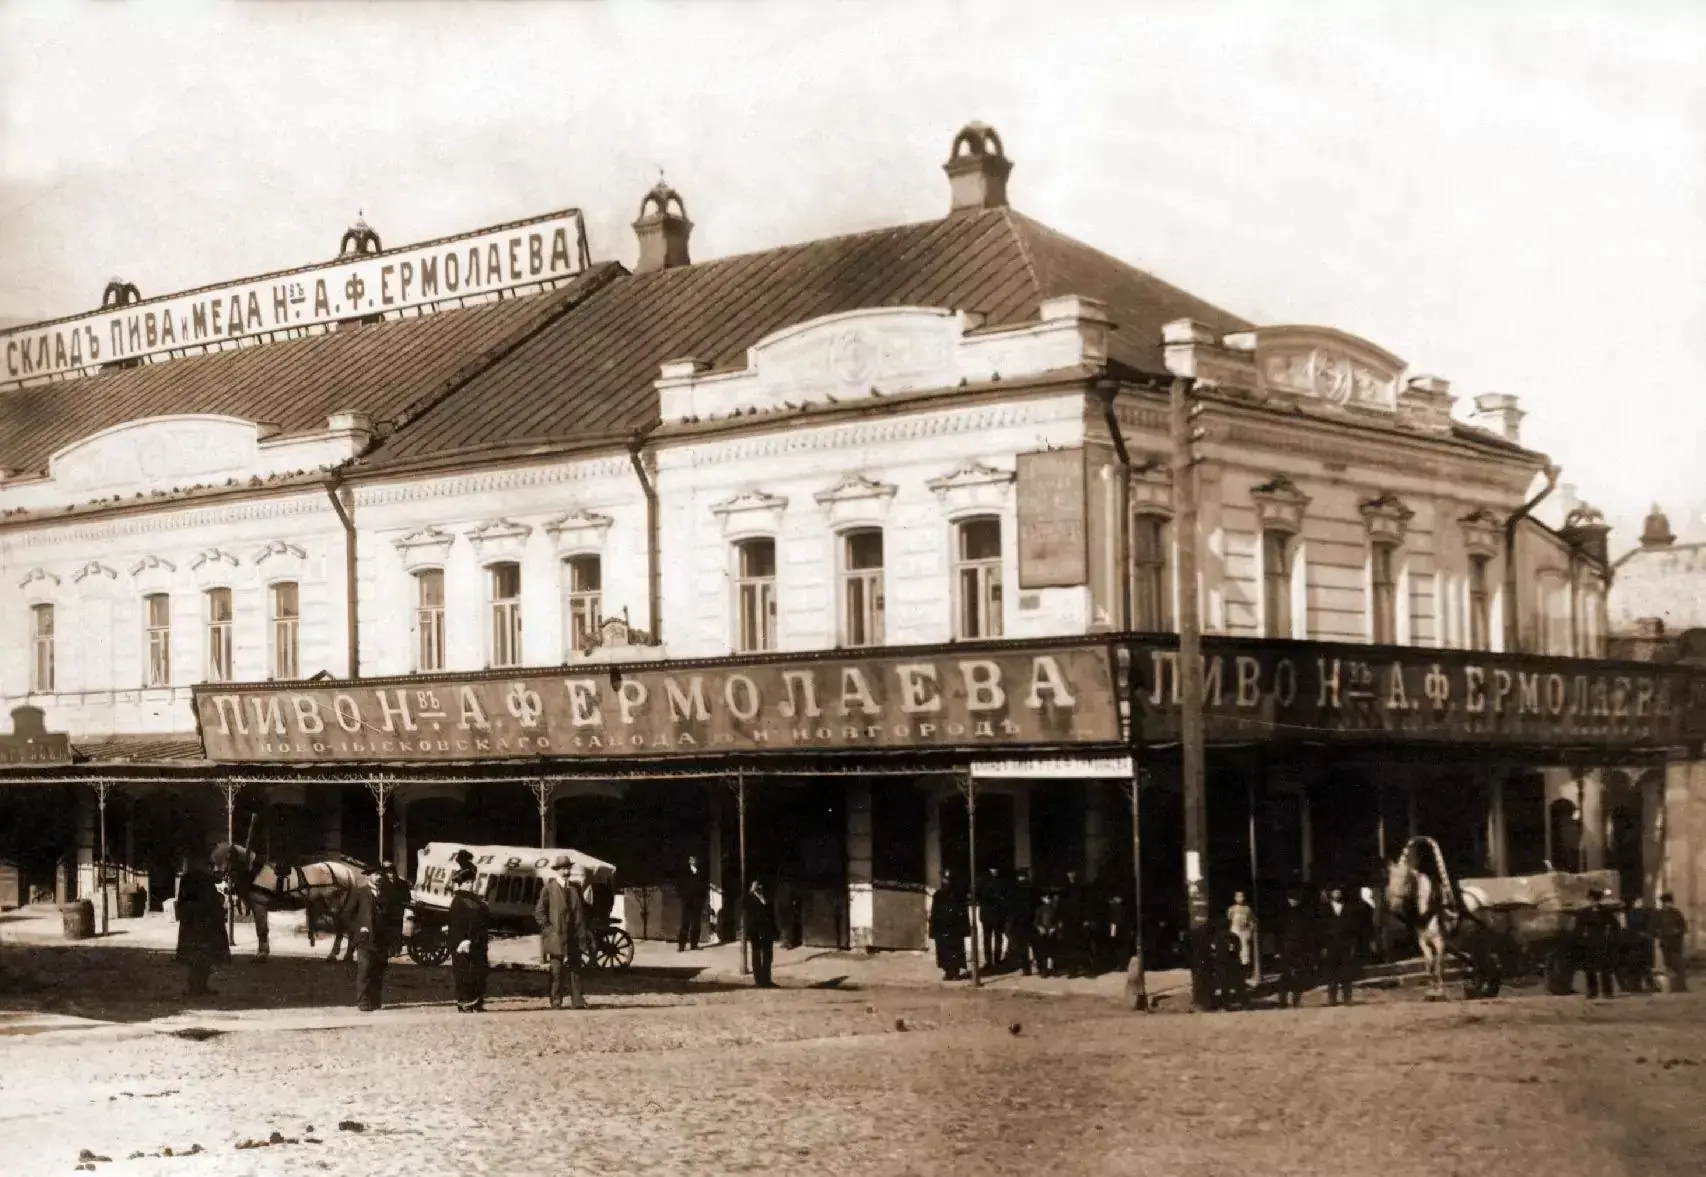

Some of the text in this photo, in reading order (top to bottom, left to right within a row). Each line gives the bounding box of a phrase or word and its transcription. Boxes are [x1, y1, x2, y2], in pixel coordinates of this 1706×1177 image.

[7, 325, 100, 377] СКЛАДЪ
[110, 308, 176, 356] ПИВА
[192, 291, 262, 339] МЕДА
[381, 228, 571, 305] ЕРМОЛАЕВА
[212, 693, 362, 736] ПИВО
[564, 656, 1075, 727] ЕРМОЛАЕВА
